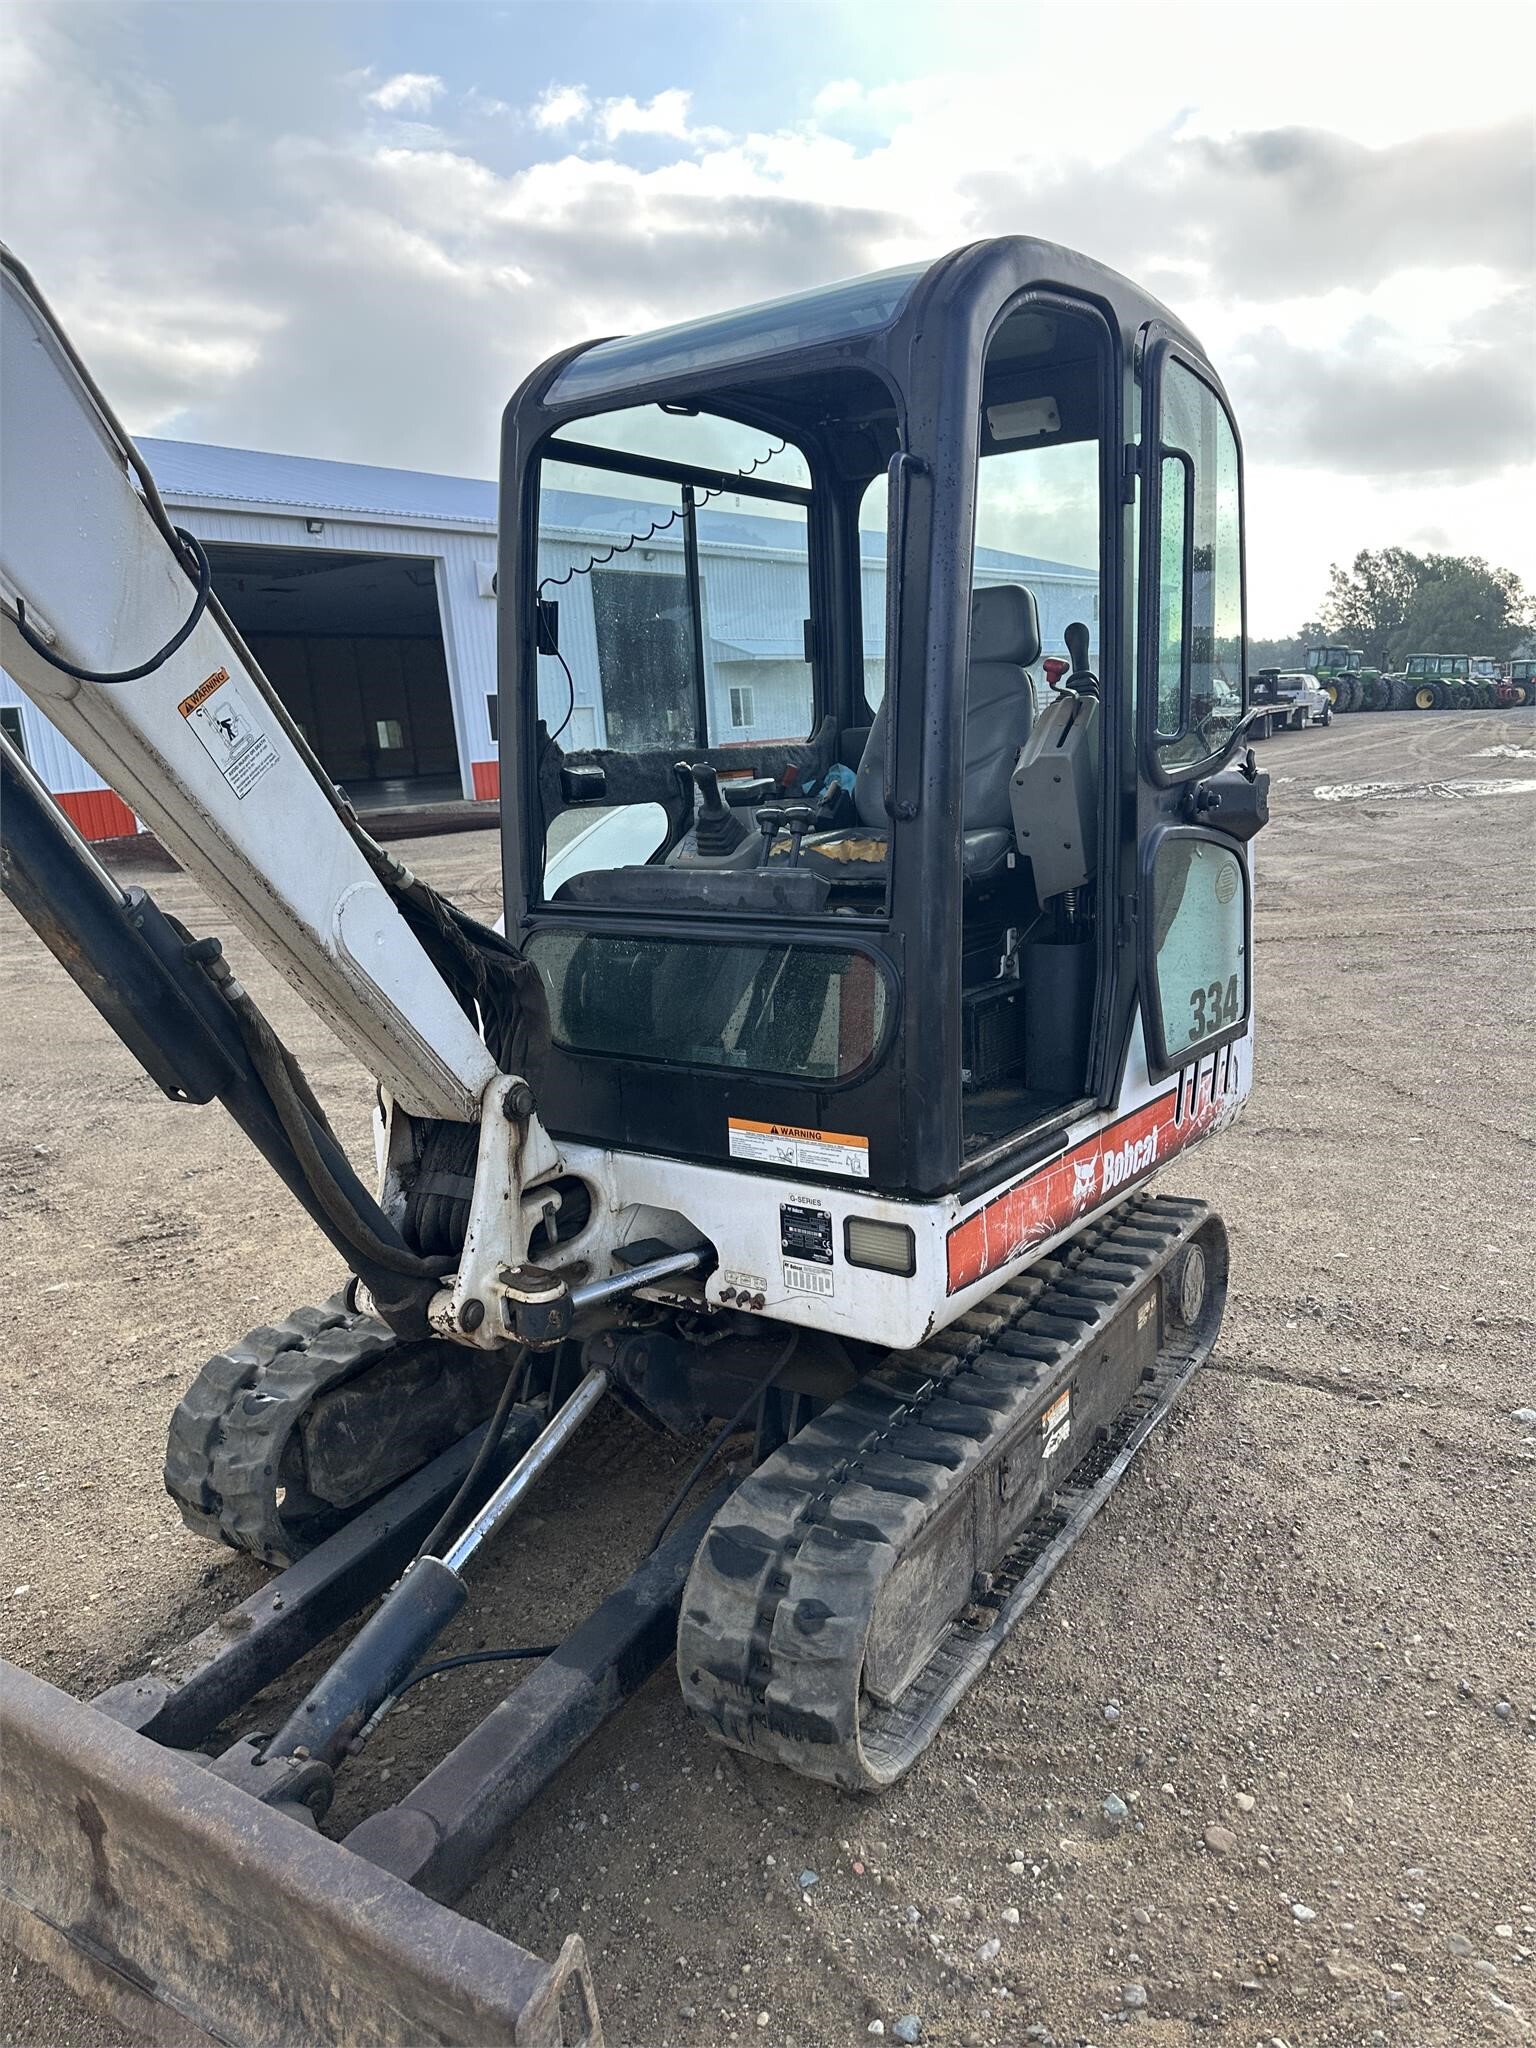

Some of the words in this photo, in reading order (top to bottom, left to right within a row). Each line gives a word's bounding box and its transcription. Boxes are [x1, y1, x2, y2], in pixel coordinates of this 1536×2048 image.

[191, 672, 225, 705] WARNING
[1188, 973, 1239, 1042] 334
[780, 1127, 822, 1141] WARNING
[1101, 1125, 1159, 1195] Bobcat
